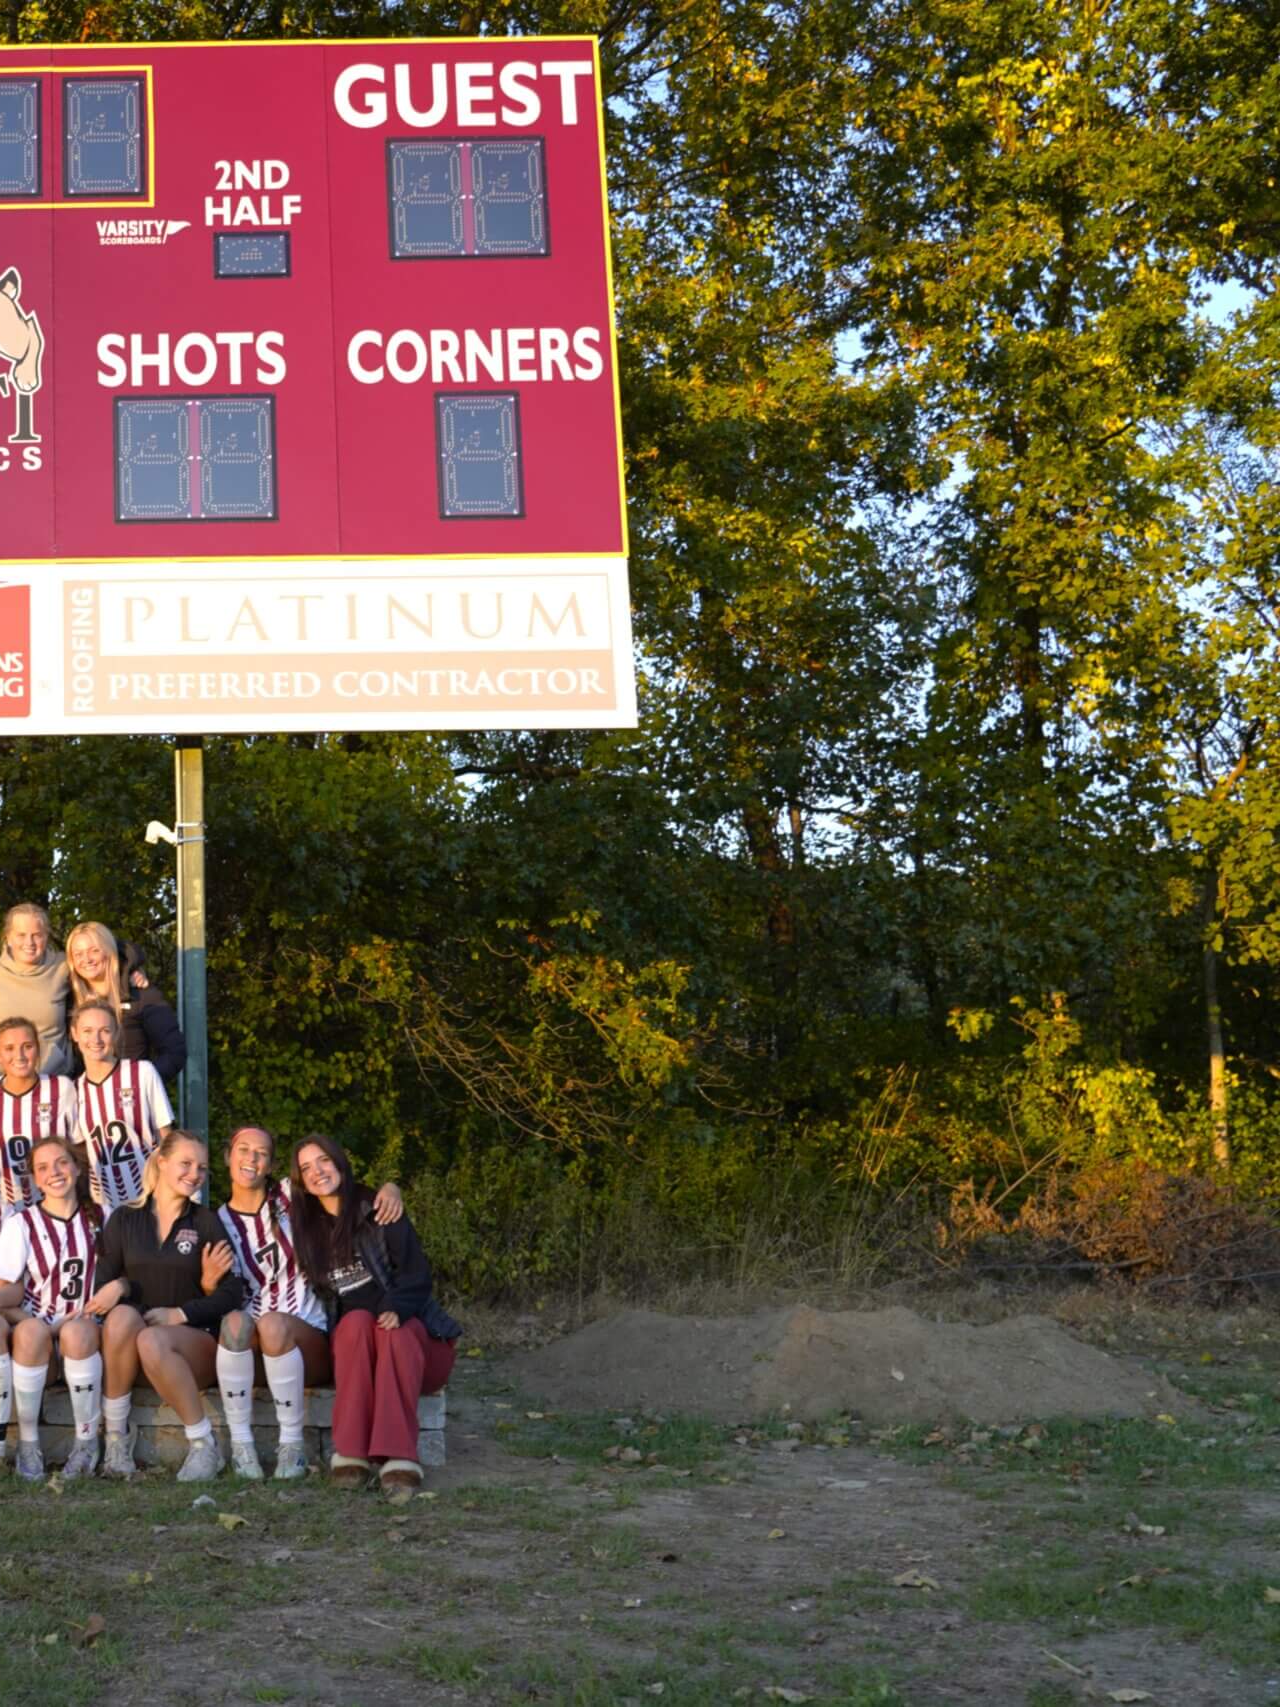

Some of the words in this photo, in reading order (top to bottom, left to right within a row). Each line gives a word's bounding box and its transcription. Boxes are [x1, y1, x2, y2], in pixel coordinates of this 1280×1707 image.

[333, 60, 593, 129] GUEST
[214, 159, 290, 191] 2ND
[95, 219, 166, 236] VARSITY
[204, 194, 302, 227] HALF
[99, 236, 162, 246] SCOREBOARDS
[96, 330, 287, 388] SHOTS
[347, 326, 604, 385] CORNERS
[122, 591, 588, 643] PLATINUM
[71, 587, 95, 713] ROOFING
[108, 671, 321, 701] PREFERRED
[332, 667, 608, 698] CONTRACTOR
[89, 1119, 136, 1167] 12
[60, 1257, 85, 1301] 3
[254, 1241, 280, 1282] 7
